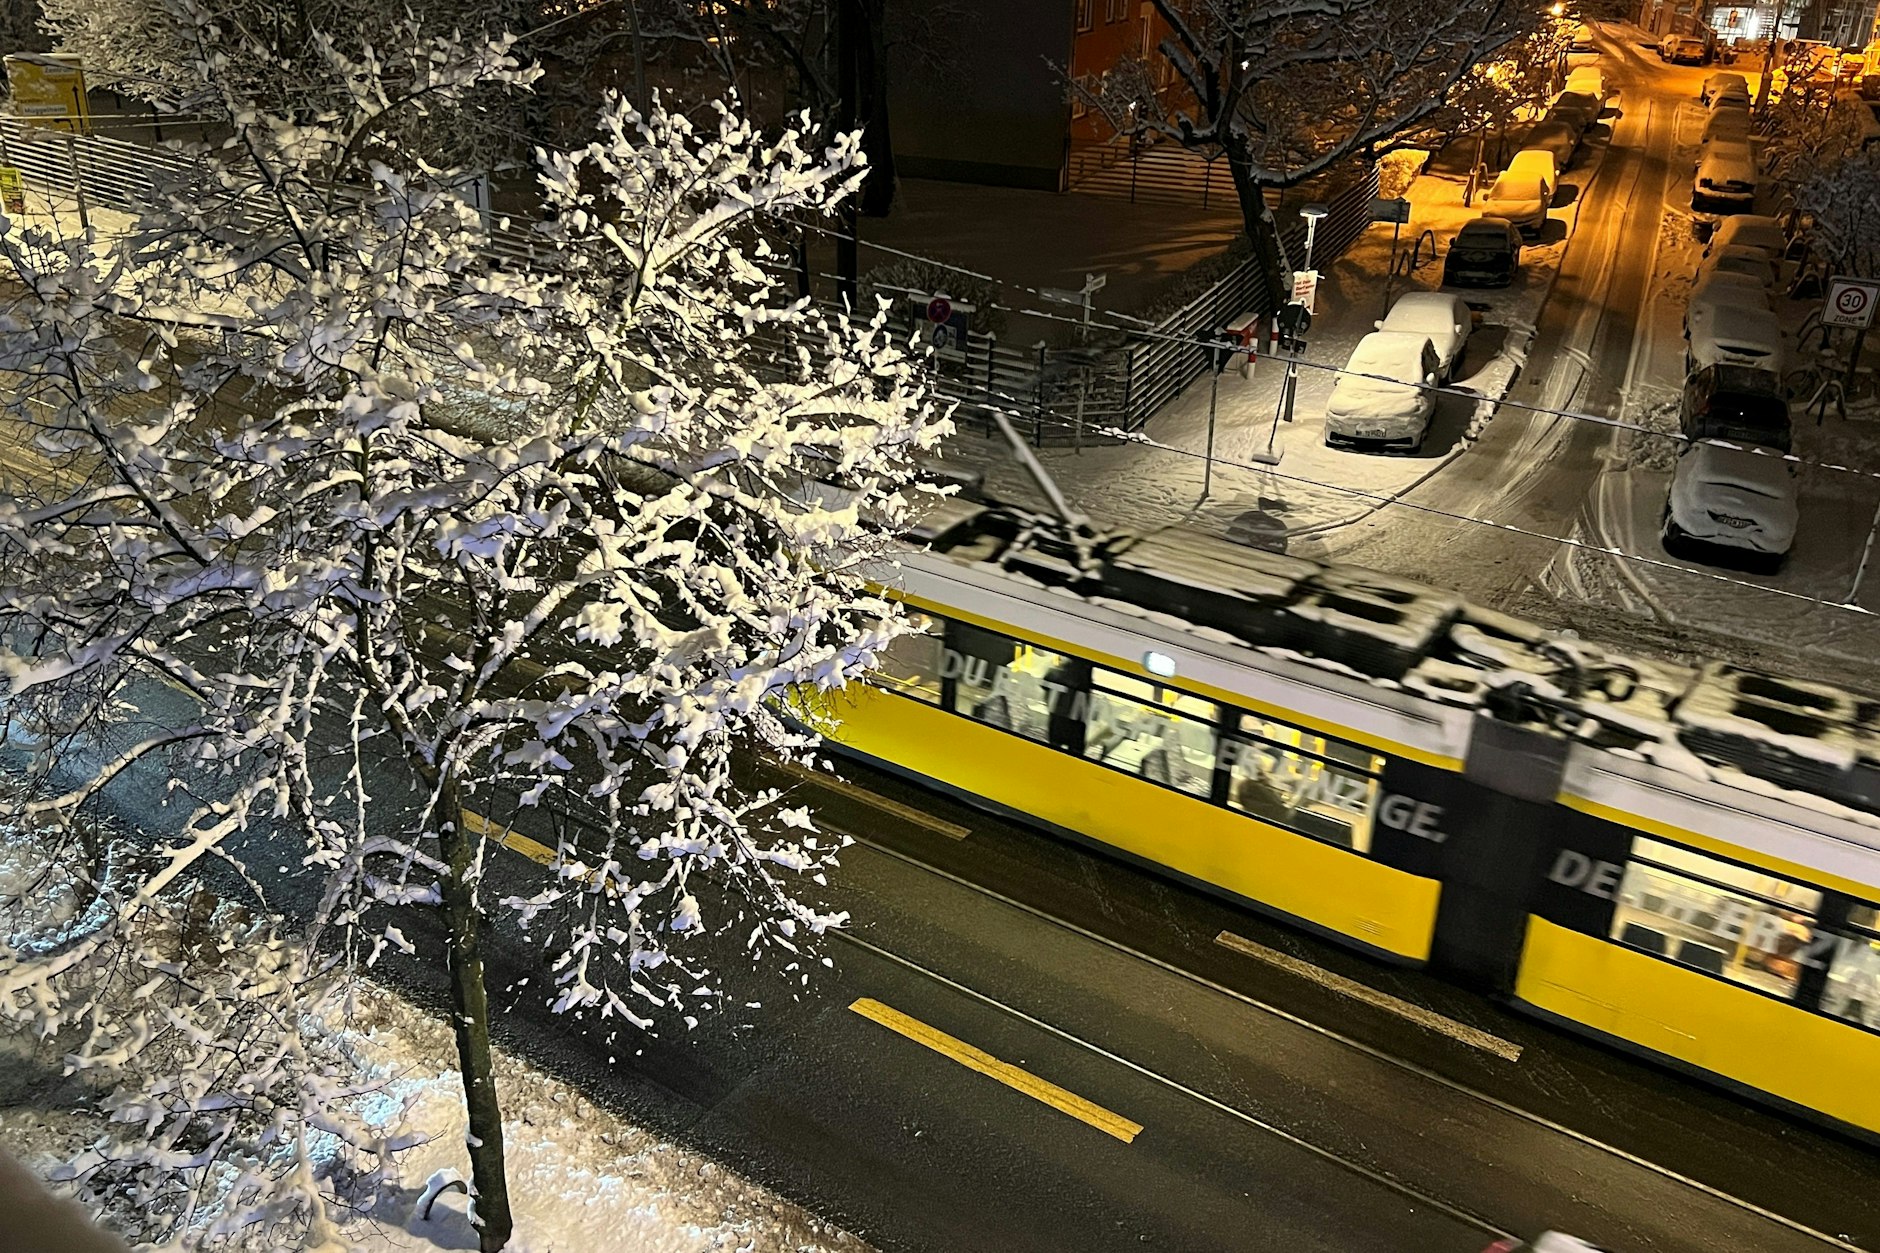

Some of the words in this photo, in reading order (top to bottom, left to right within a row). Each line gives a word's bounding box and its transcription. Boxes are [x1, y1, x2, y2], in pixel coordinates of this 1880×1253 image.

[1842, 294, 1861, 308] 30
[1833, 314, 1857, 324] ZONE
[940, 648, 991, 684] DU
